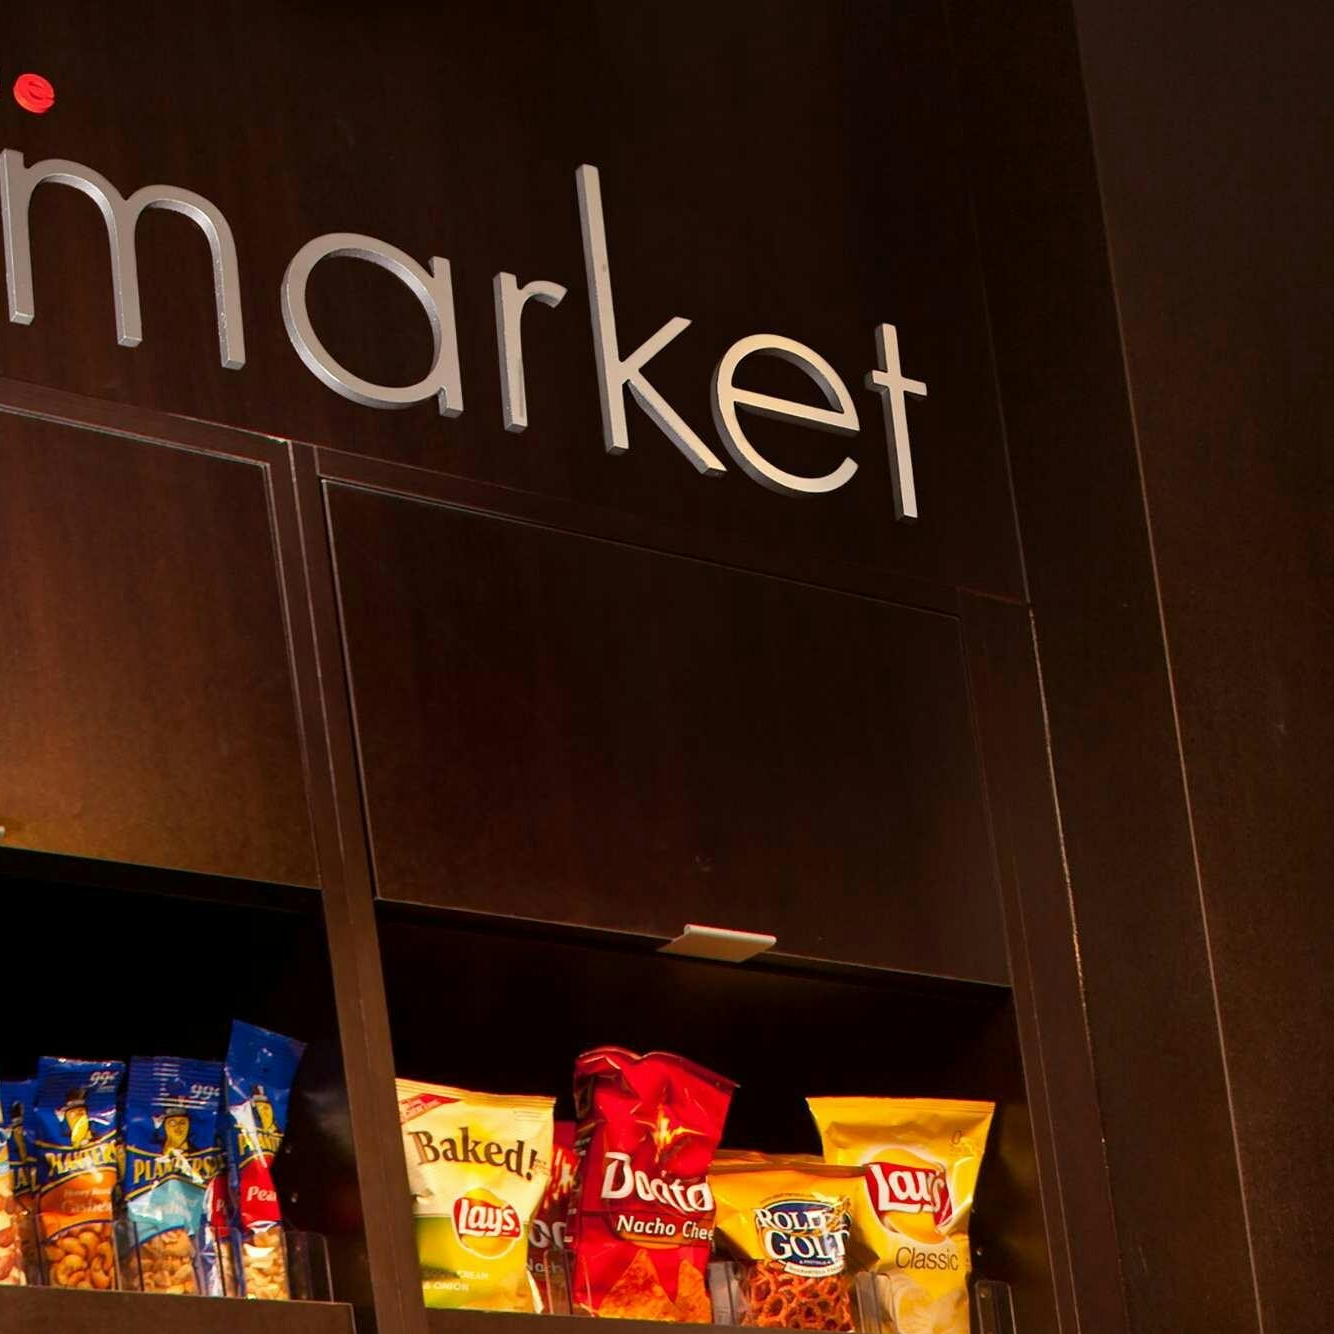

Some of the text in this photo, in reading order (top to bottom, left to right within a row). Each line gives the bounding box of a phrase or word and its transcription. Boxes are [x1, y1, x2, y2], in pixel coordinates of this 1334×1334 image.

[408, 1126, 538, 1182] Baked!
[247, 1185, 278, 1204] Pea
[600, 1150, 715, 1214] Dorito
[457, 1197, 520, 1237] Lay's
[617, 1214, 715, 1243] Nacho Chee
[894, 1246, 960, 1272] Classic
